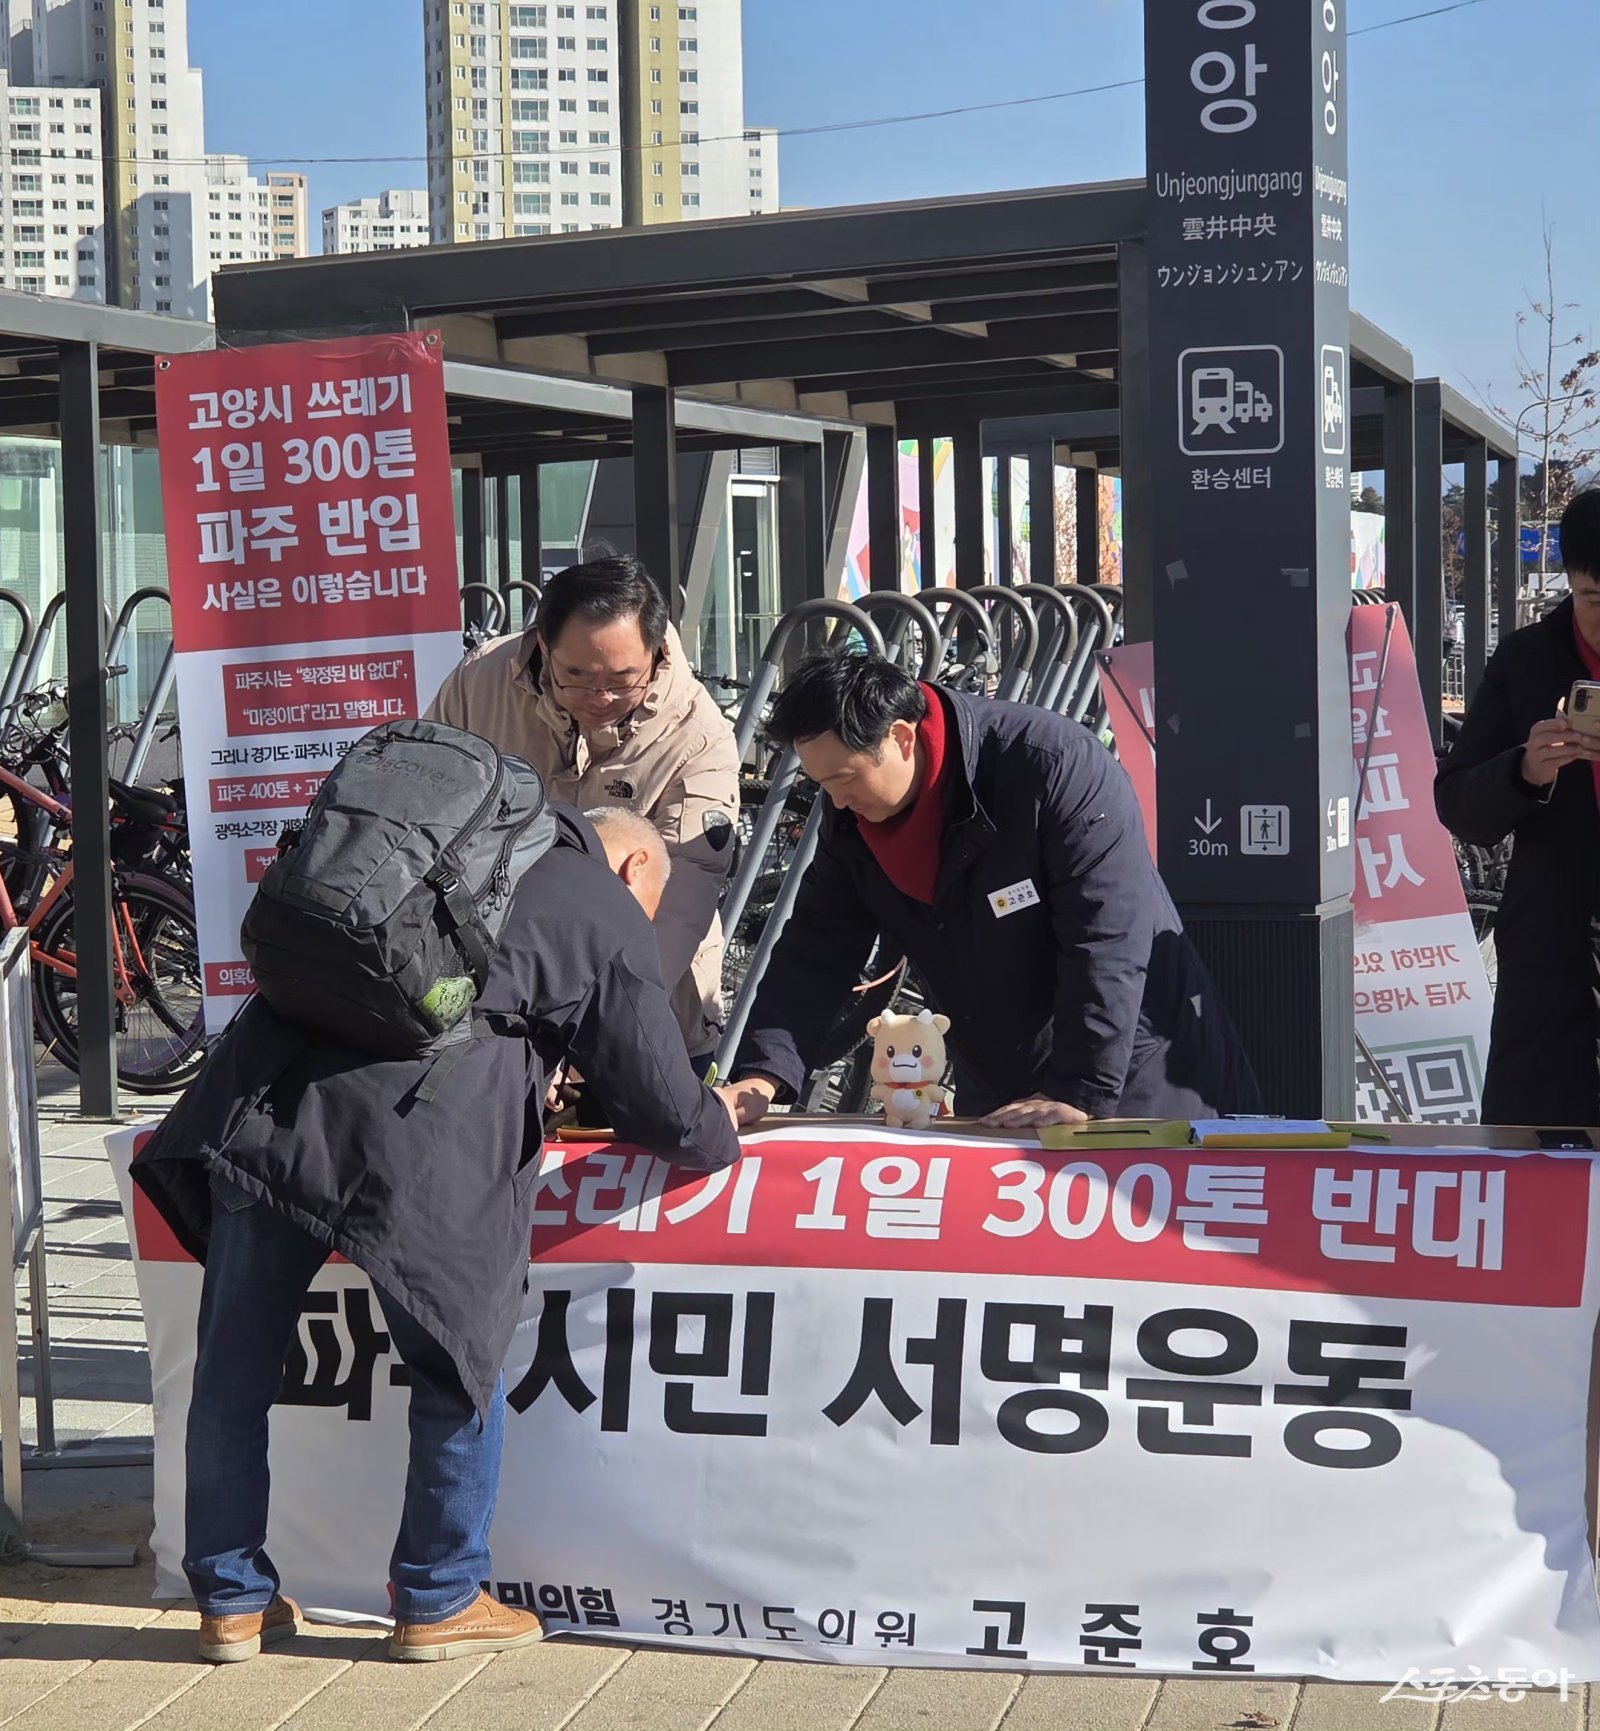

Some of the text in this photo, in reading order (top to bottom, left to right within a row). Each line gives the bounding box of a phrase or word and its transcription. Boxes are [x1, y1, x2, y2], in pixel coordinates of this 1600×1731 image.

[1156, 168, 1303, 203] Unjeongjungang
[1182, 212, 1277, 241] 雲井中央
[1157, 259, 1303, 288] ウンジョンシュンアン
[188, 373, 412, 430] 고양시 쓰레기
[192, 428, 416, 493] 1일 300톤
[1190, 466, 1271, 490] 환승센터
[196, 493, 421, 566] 파주 반입
[202, 566, 427, 612] 사실은 이렇습니다
[235, 670, 293, 690] 파주시는
[349, 664, 365, 682] 바
[343, 698, 406, 717] 말합니다.
[210, 748, 249, 766] 그러나
[217, 784, 247, 802] 파주
[249, 780, 290, 799] 400톤
[215, 820, 278, 840] 광역소각장
[1188, 838, 1228, 856] 30m
[795, 1156, 951, 1241] 1일
[982, 1159, 1269, 1255] 300톤
[1312, 1167, 1506, 1272] 반대
[821, 1296, 1412, 1469] 서명운동
